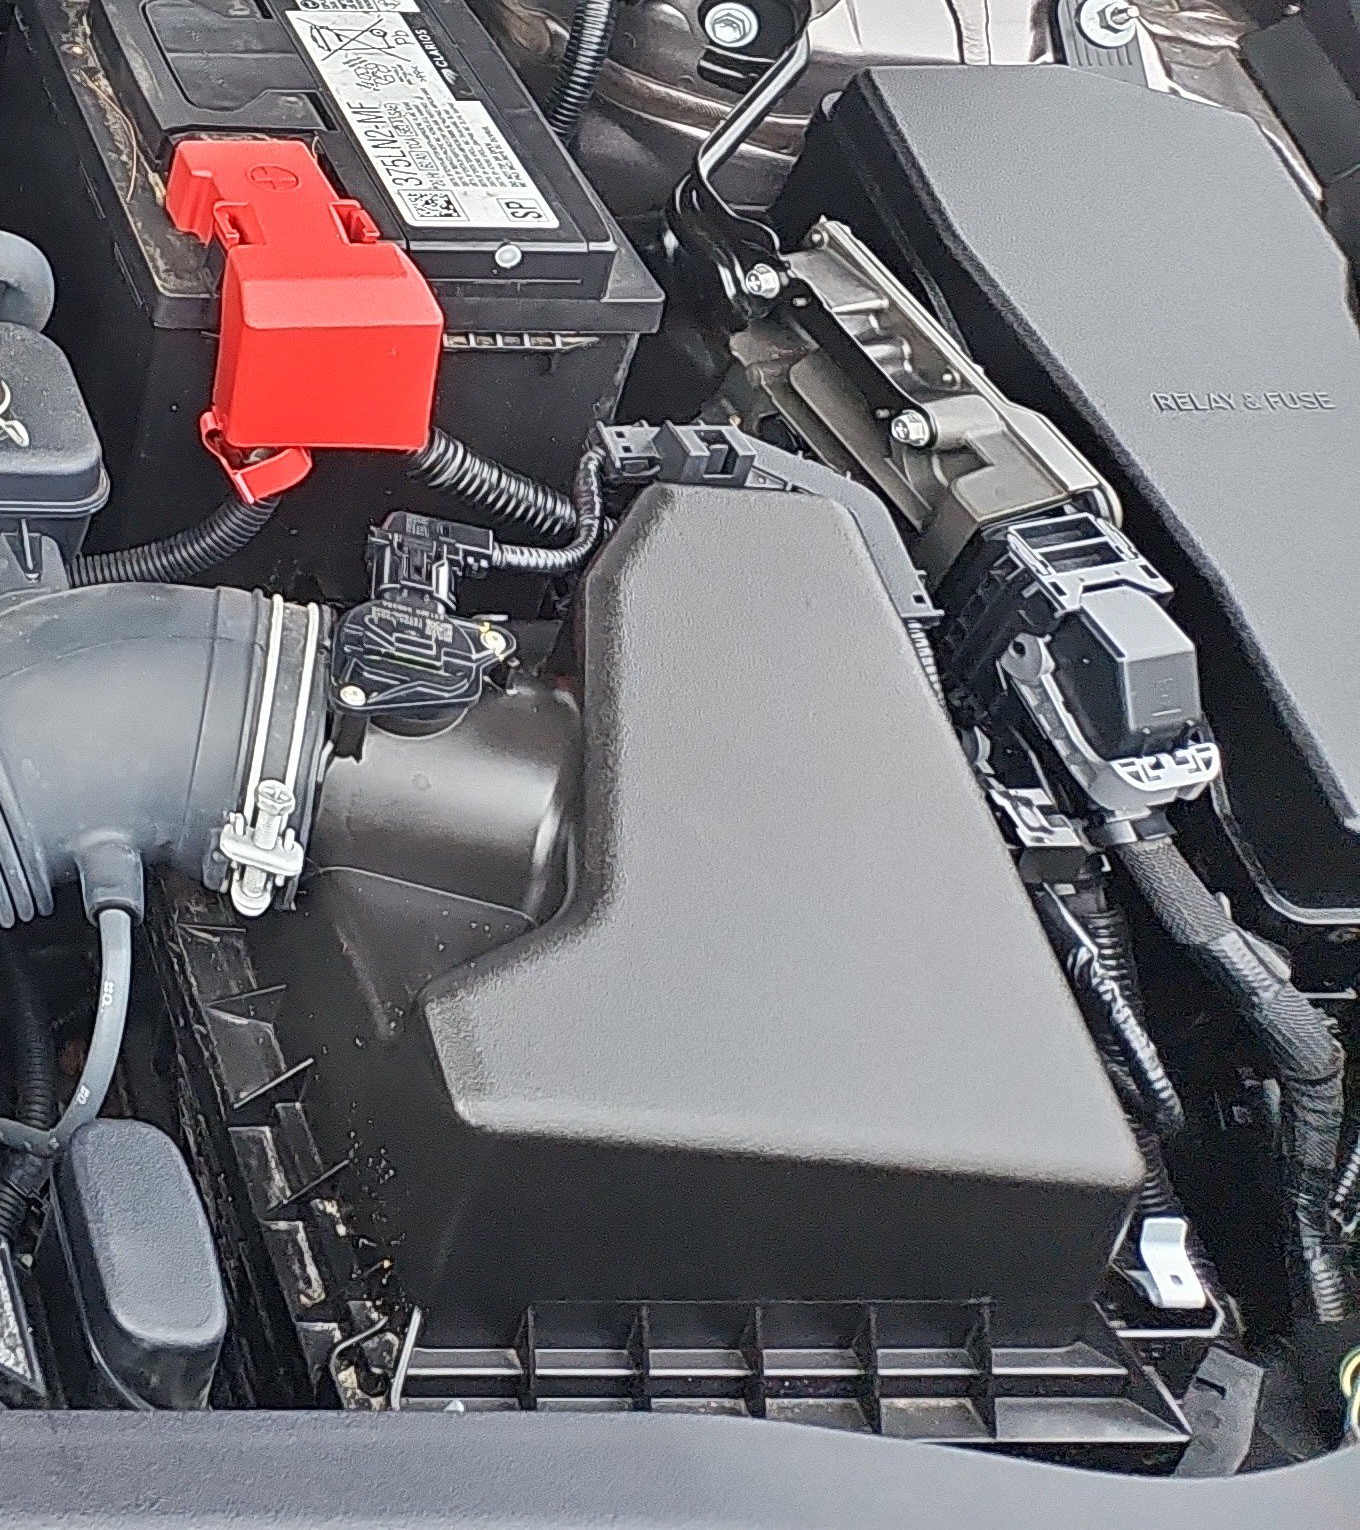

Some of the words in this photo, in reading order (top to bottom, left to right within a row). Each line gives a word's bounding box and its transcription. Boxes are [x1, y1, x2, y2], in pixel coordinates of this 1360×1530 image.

[391, 29, 415, 46] Pb
[415, 28, 449, 69] CLARIOS
[346, 101, 423, 187] 375LN2-MF
[504, 200, 544, 220] SP
[1151, 392, 1237, 413] RELAY
[1242, 393, 1263, 410] &
[1263, 391, 1336, 411] FUSE
